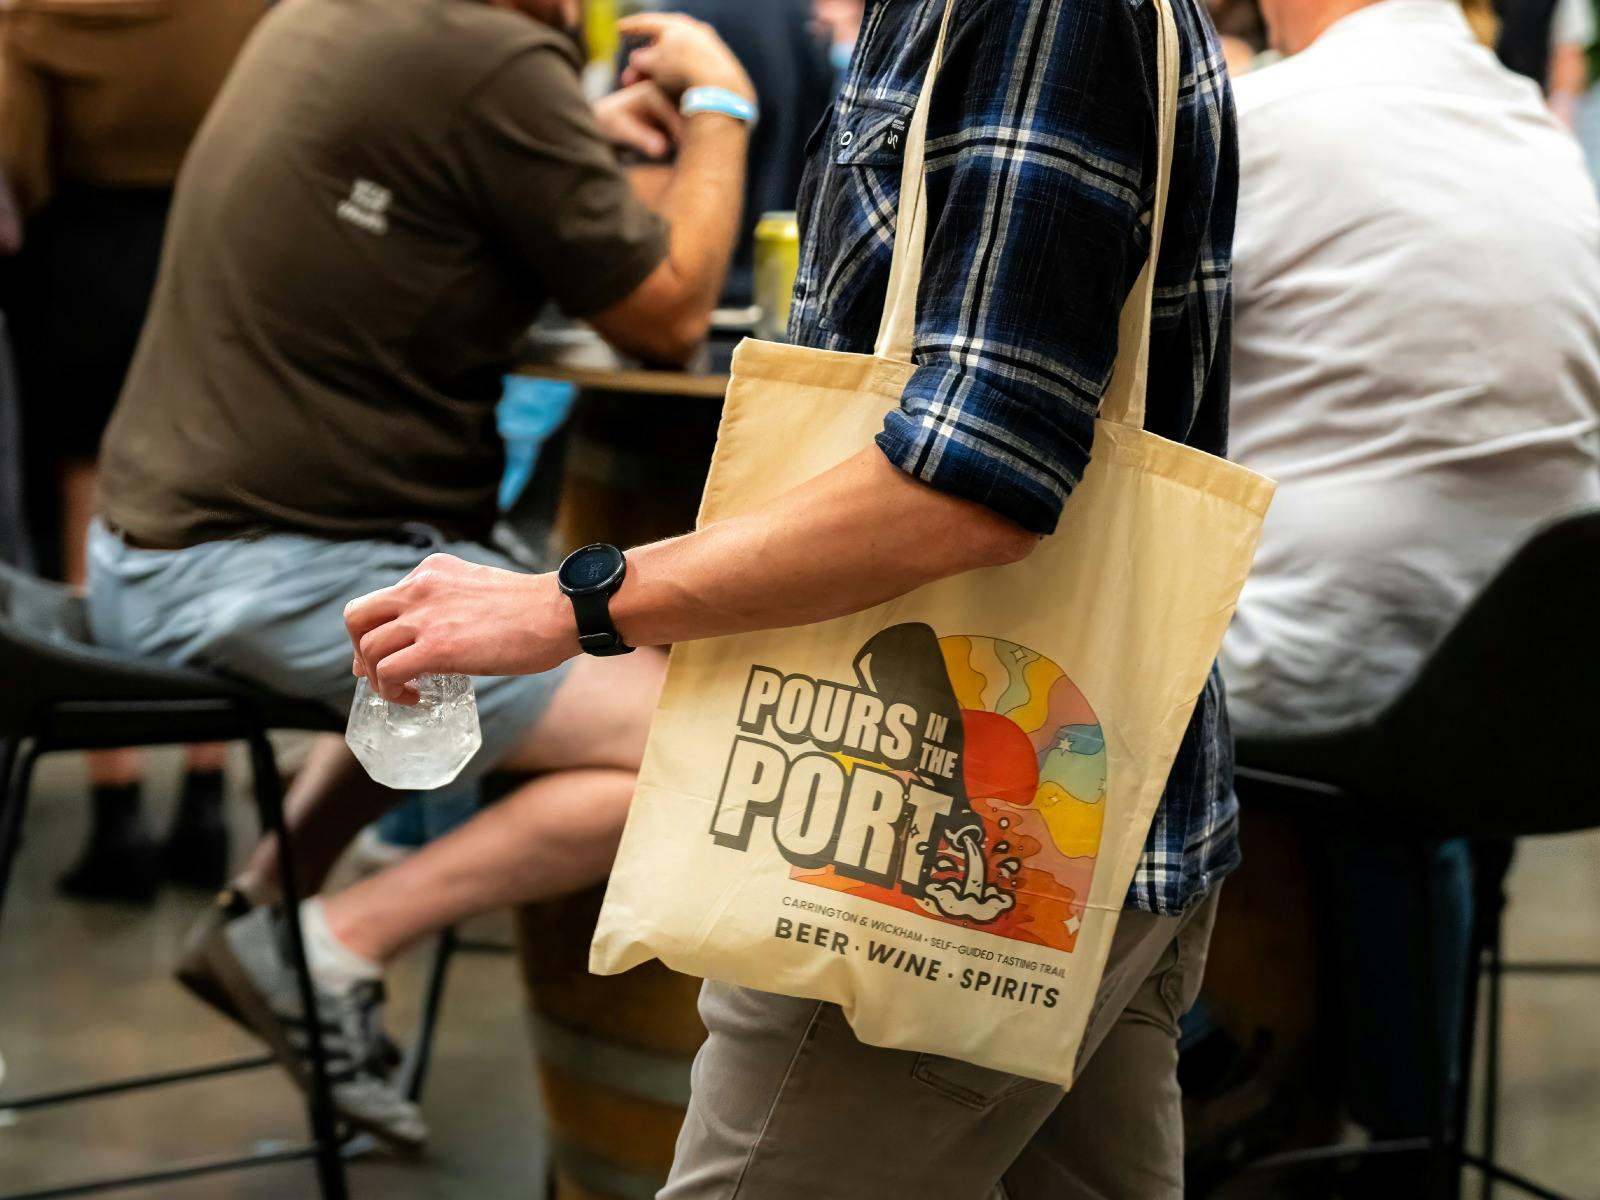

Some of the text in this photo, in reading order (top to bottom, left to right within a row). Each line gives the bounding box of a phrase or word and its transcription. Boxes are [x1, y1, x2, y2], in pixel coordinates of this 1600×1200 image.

[738, 666, 919, 766] POURS
[924, 712, 949, 744] IN
[919, 742, 959, 779] THE
[710, 736, 954, 892] PORT
[774, 917, 1060, 1009] BEER WINE SPIRITS
[782, 896, 1066, 979] CARRINGTON & WICKHAM SELF-GUIDED TASTING TRAIL
